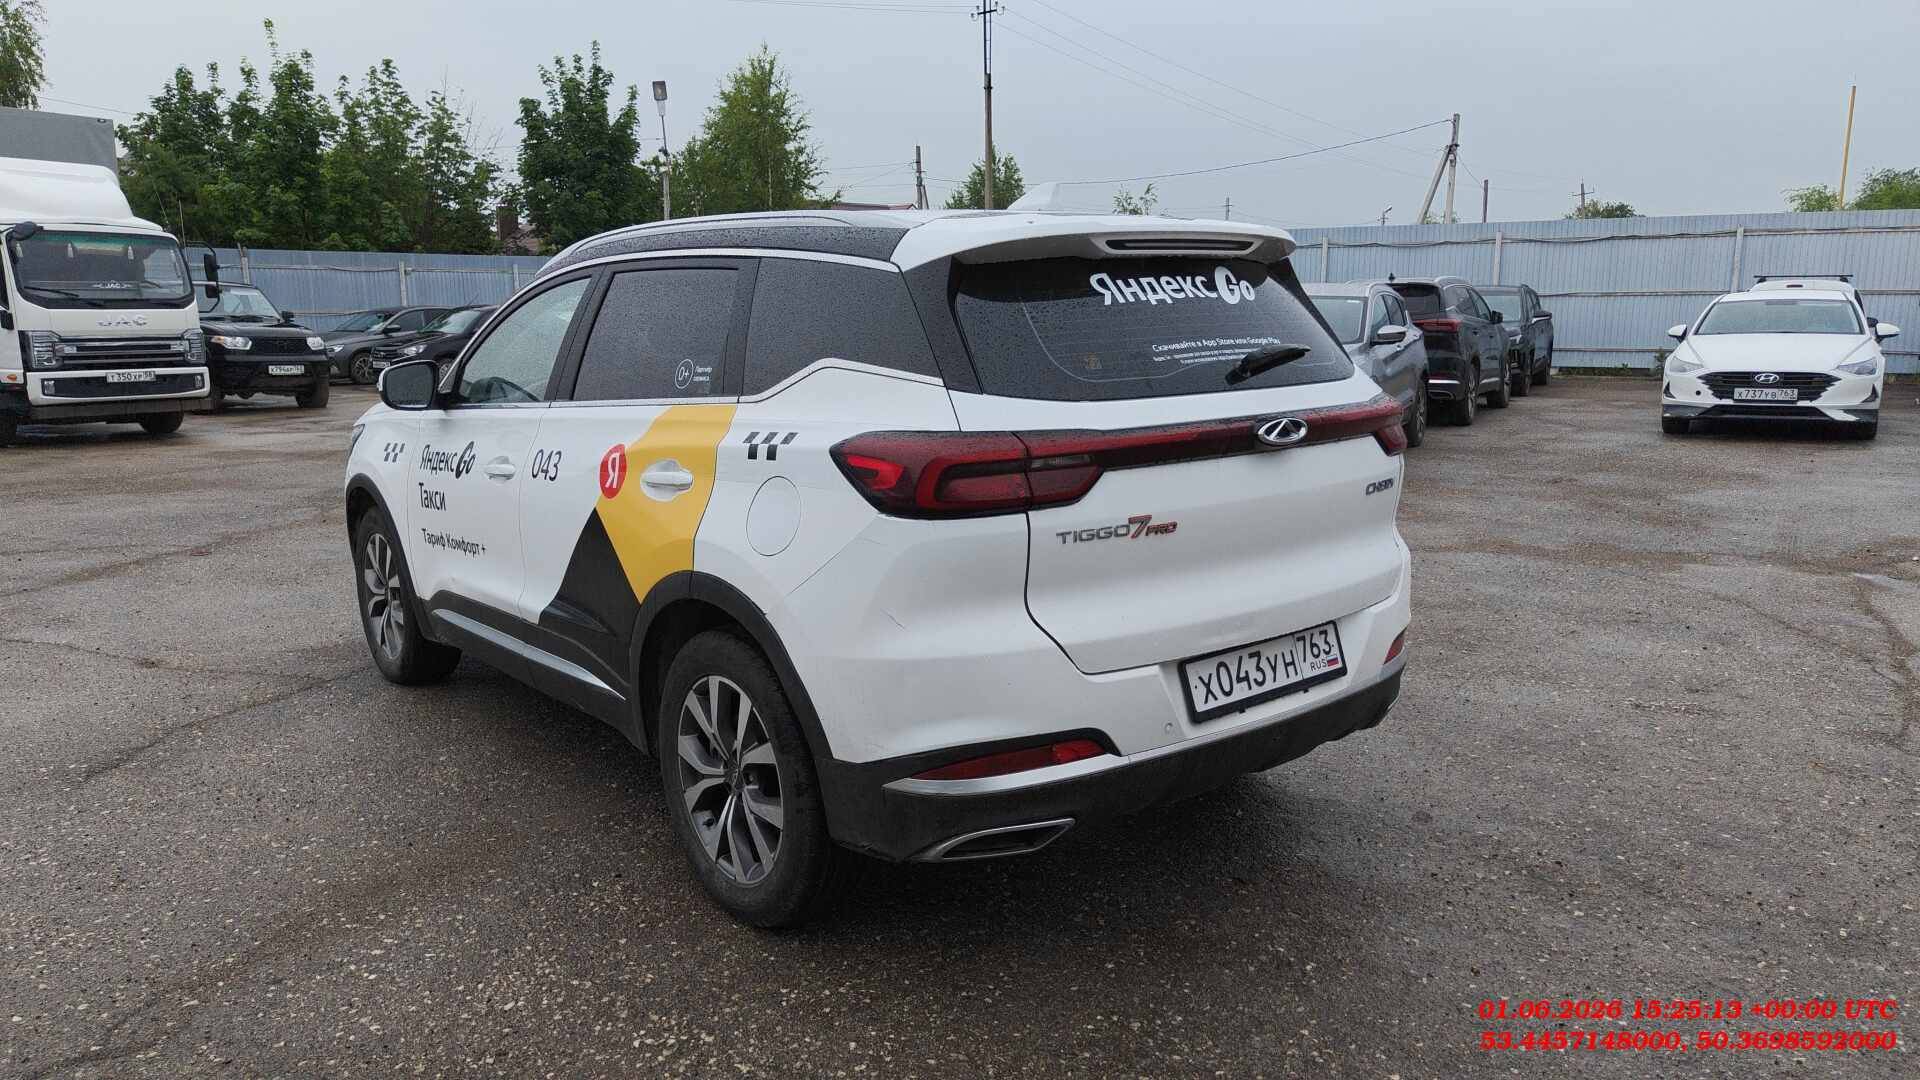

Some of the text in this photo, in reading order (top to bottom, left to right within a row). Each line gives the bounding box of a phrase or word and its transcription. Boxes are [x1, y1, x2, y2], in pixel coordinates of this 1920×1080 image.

[1089, 266, 1256, 305] Яндекс Go
[419, 441, 476, 479] Яндекс Go
[531, 449, 562, 481] 043
[604, 452, 620, 489] Я
[418, 482, 447, 511] Такси
[421, 528, 446, 550] Тариф
[446, 533, 480, 558] Комфорт
[1056, 524, 1130, 544] TIGGO
[1310, 658, 1327, 671] RUS
